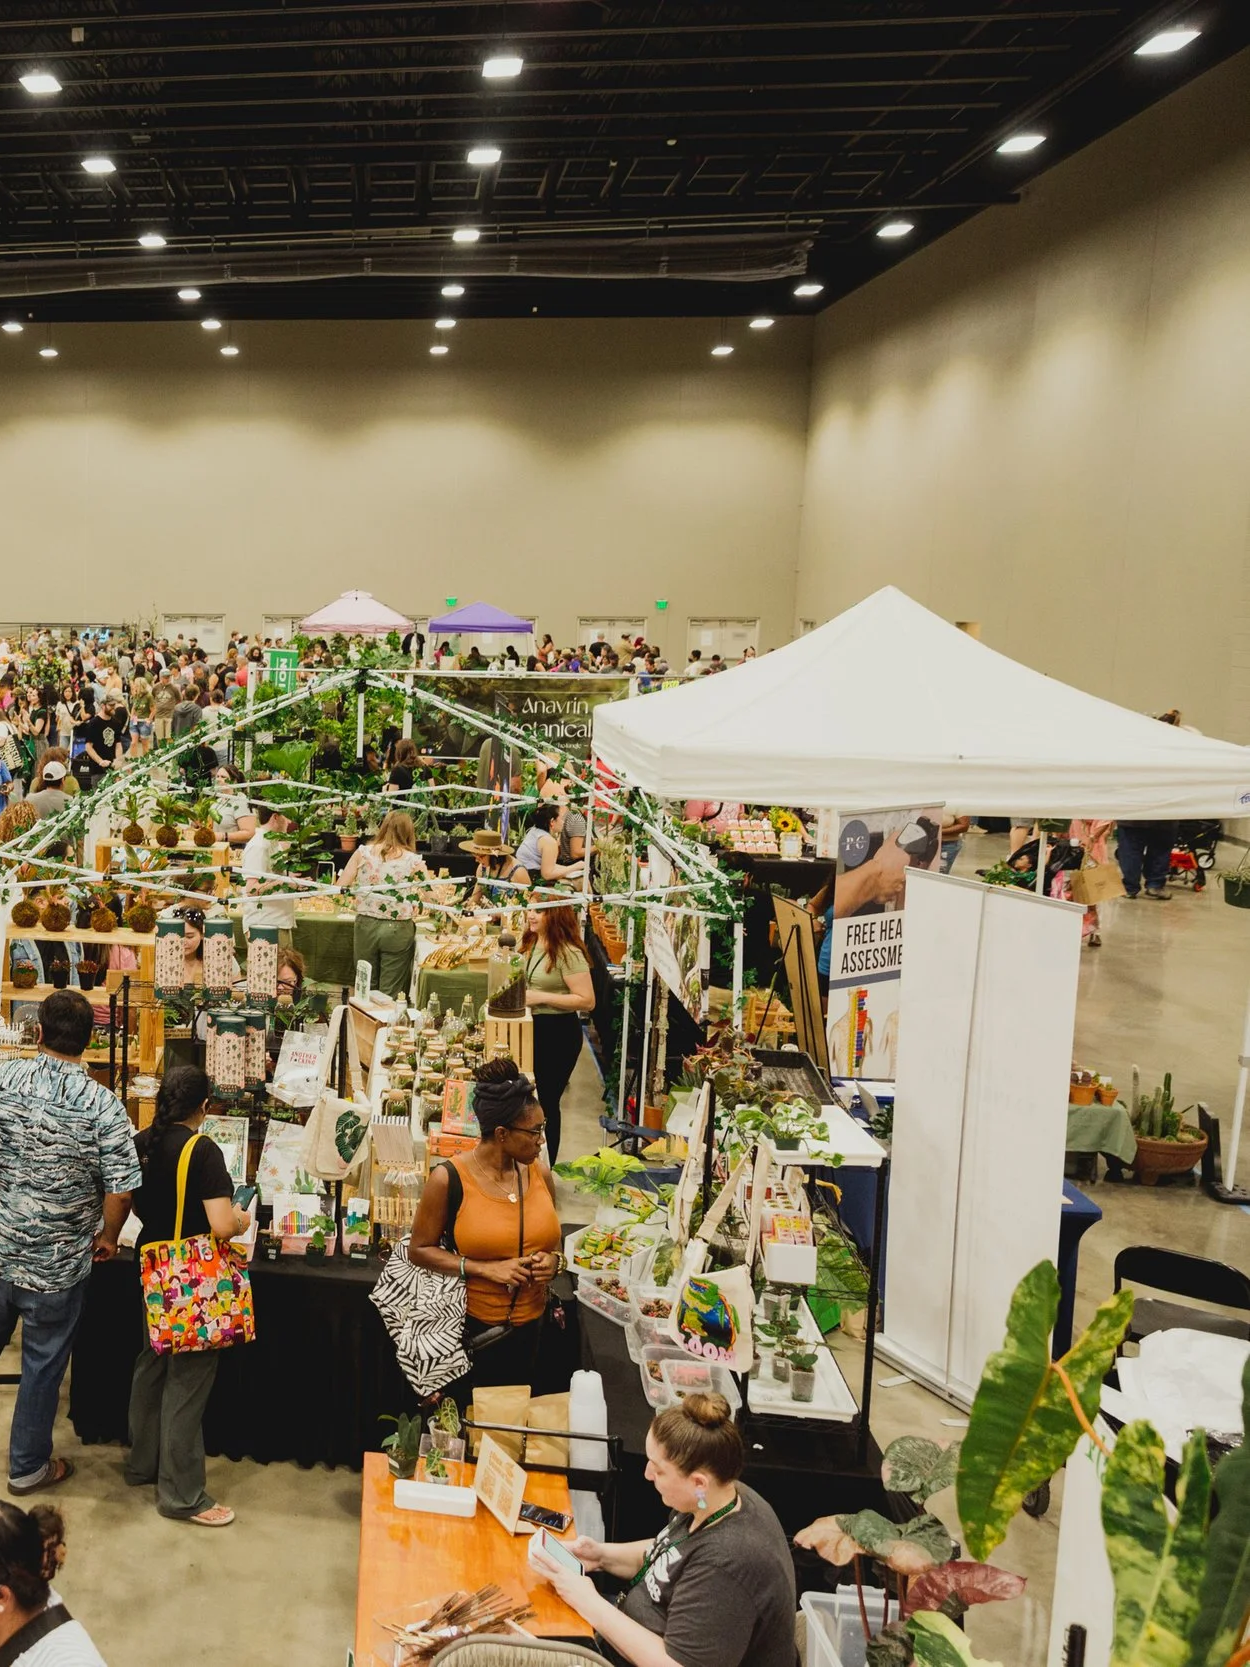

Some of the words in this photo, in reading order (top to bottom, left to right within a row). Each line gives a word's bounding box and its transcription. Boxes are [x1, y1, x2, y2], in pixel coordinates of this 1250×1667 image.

[522, 697, 589, 714] Anavrin
[517, 719, 591, 738] otanical
[846, 921, 877, 947] FREE
[879, 918, 903, 942] HEA
[841, 944, 902, 974] ASSESSME
